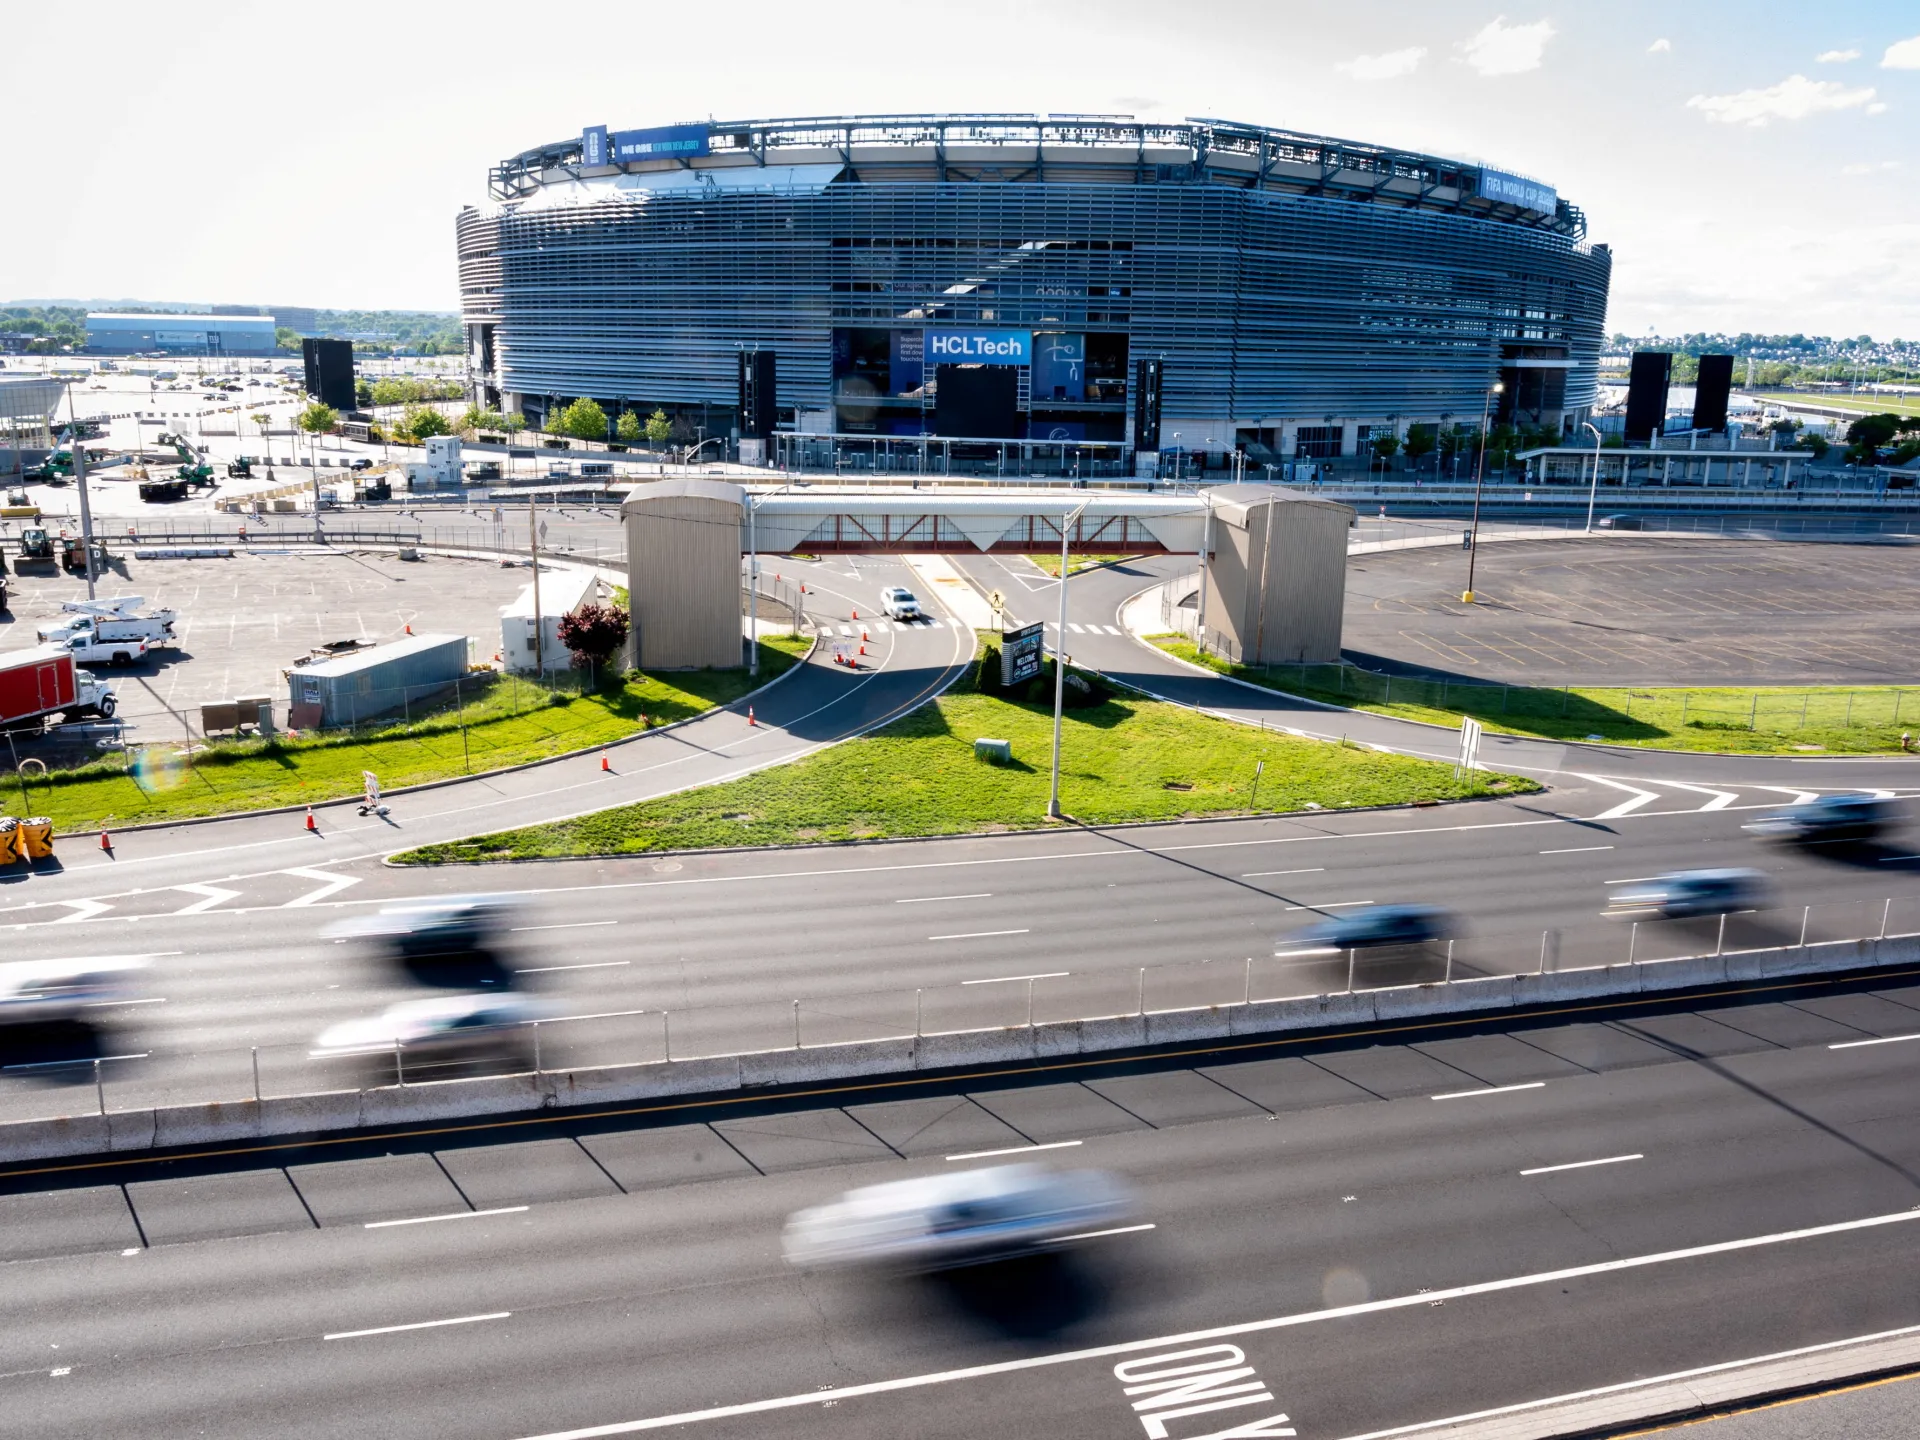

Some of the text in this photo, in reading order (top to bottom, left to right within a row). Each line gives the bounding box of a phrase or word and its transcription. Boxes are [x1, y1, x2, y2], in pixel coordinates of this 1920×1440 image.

[1486, 176, 1501, 193] FIFA
[1502, 180, 1525, 198] WORLD
[1525, 187, 1538, 201] CUP
[932, 335, 1022, 356] HCLTech
[1464, 541, 1470, 549] 2
[93, 550, 101, 558] D
[1016, 652, 1036, 666] WELCOME
[1114, 1344, 1297, 1440] ONLY
